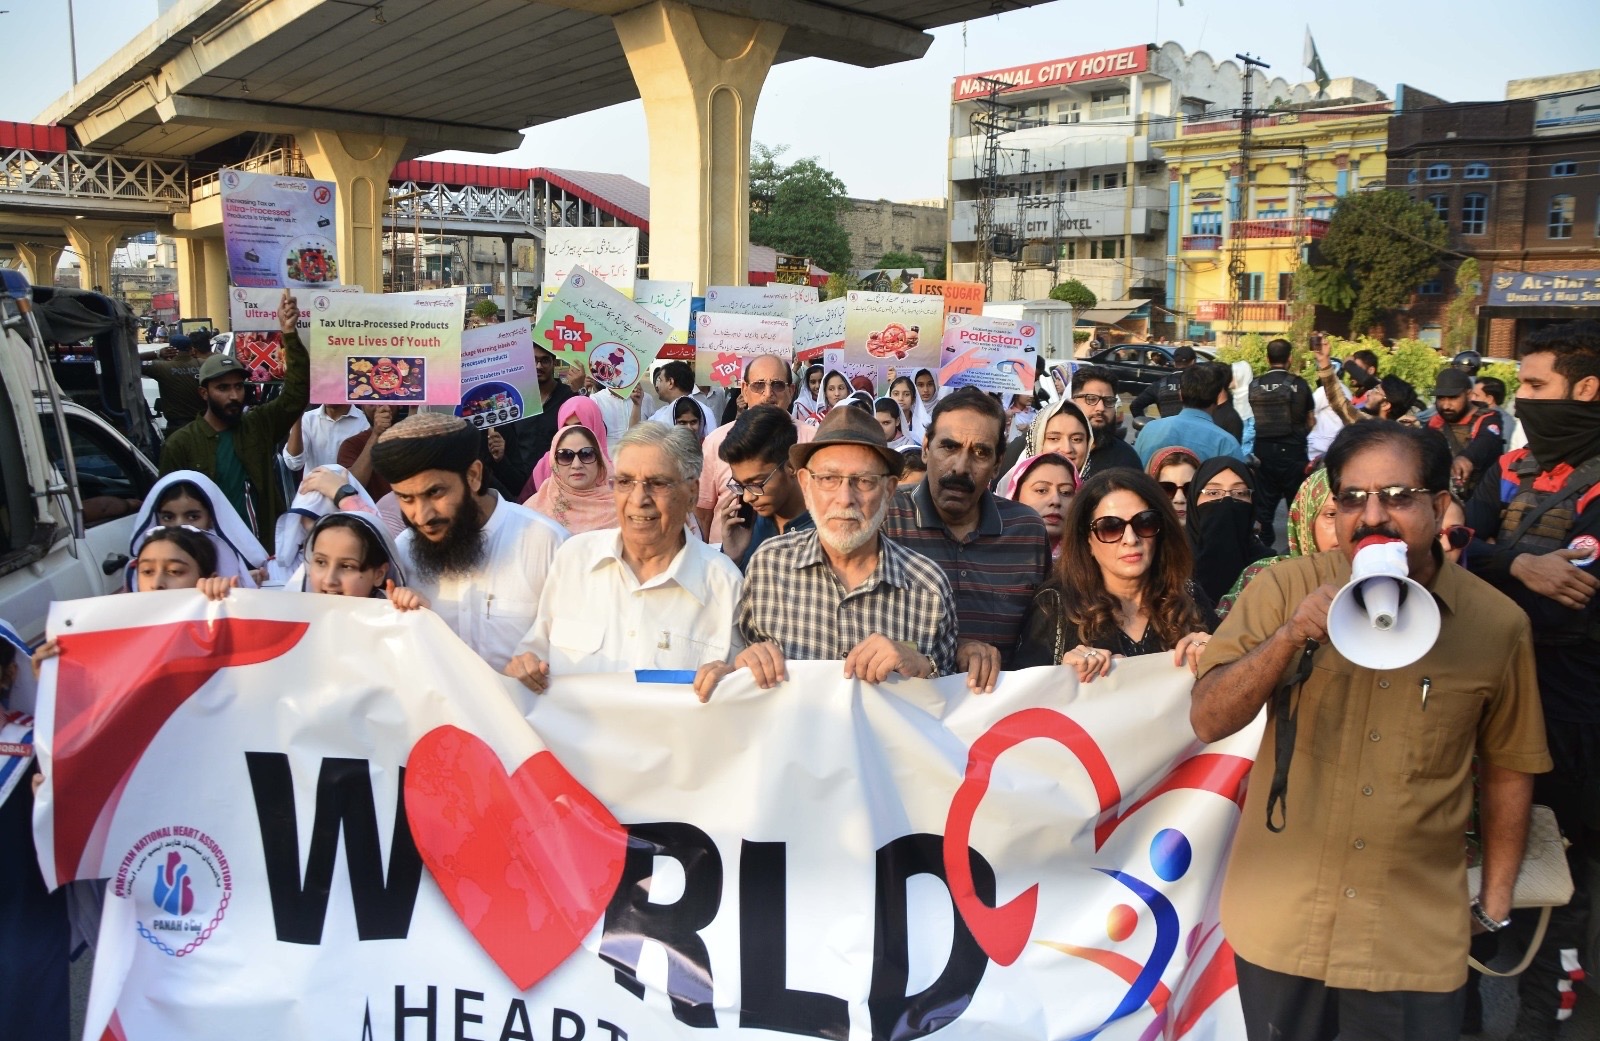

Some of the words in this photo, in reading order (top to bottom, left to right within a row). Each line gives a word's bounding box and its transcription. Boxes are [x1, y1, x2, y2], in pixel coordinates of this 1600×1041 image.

[959, 69, 1034, 95] NATIONAL
[1038, 61, 1077, 82] CITY
[1080, 51, 1138, 76] HOTEL
[226, 204, 291, 216] Ultra-Processed
[1027, 220, 1048, 232] CITY
[1060, 218, 1092, 230] HOTEL
[469, 286, 488, 294] HOTEL
[945, 286, 980, 301] SUGAR
[244, 301, 258, 309] Tax
[320, 318, 336, 328] Tax
[338, 318, 408, 329] Ultra-Processed
[410, 320, 449, 330] Products
[556, 325, 582, 342] Tax
[960, 330, 1023, 346] Pakistan
[328, 335, 355, 346] Save
[358, 335, 387, 346] Lives
[391, 336, 405, 347] Of
[406, 336, 441, 347] Youth
[477, 345, 497, 354] Warning
[487, 353, 508, 363] Products
[461, 374, 480, 384] Control
[480, 370, 501, 380] Diabetes
[506, 365, 525, 374] Pakistan
[716, 360, 740, 377] Tax
[115, 849, 137, 898] PAKISTAN
[133, 826, 172, 853] NATIONAL
[173, 825, 200, 840] HEART
[198, 832, 232, 891] ASSOCIATION
[153, 919, 183, 932] PANAH
